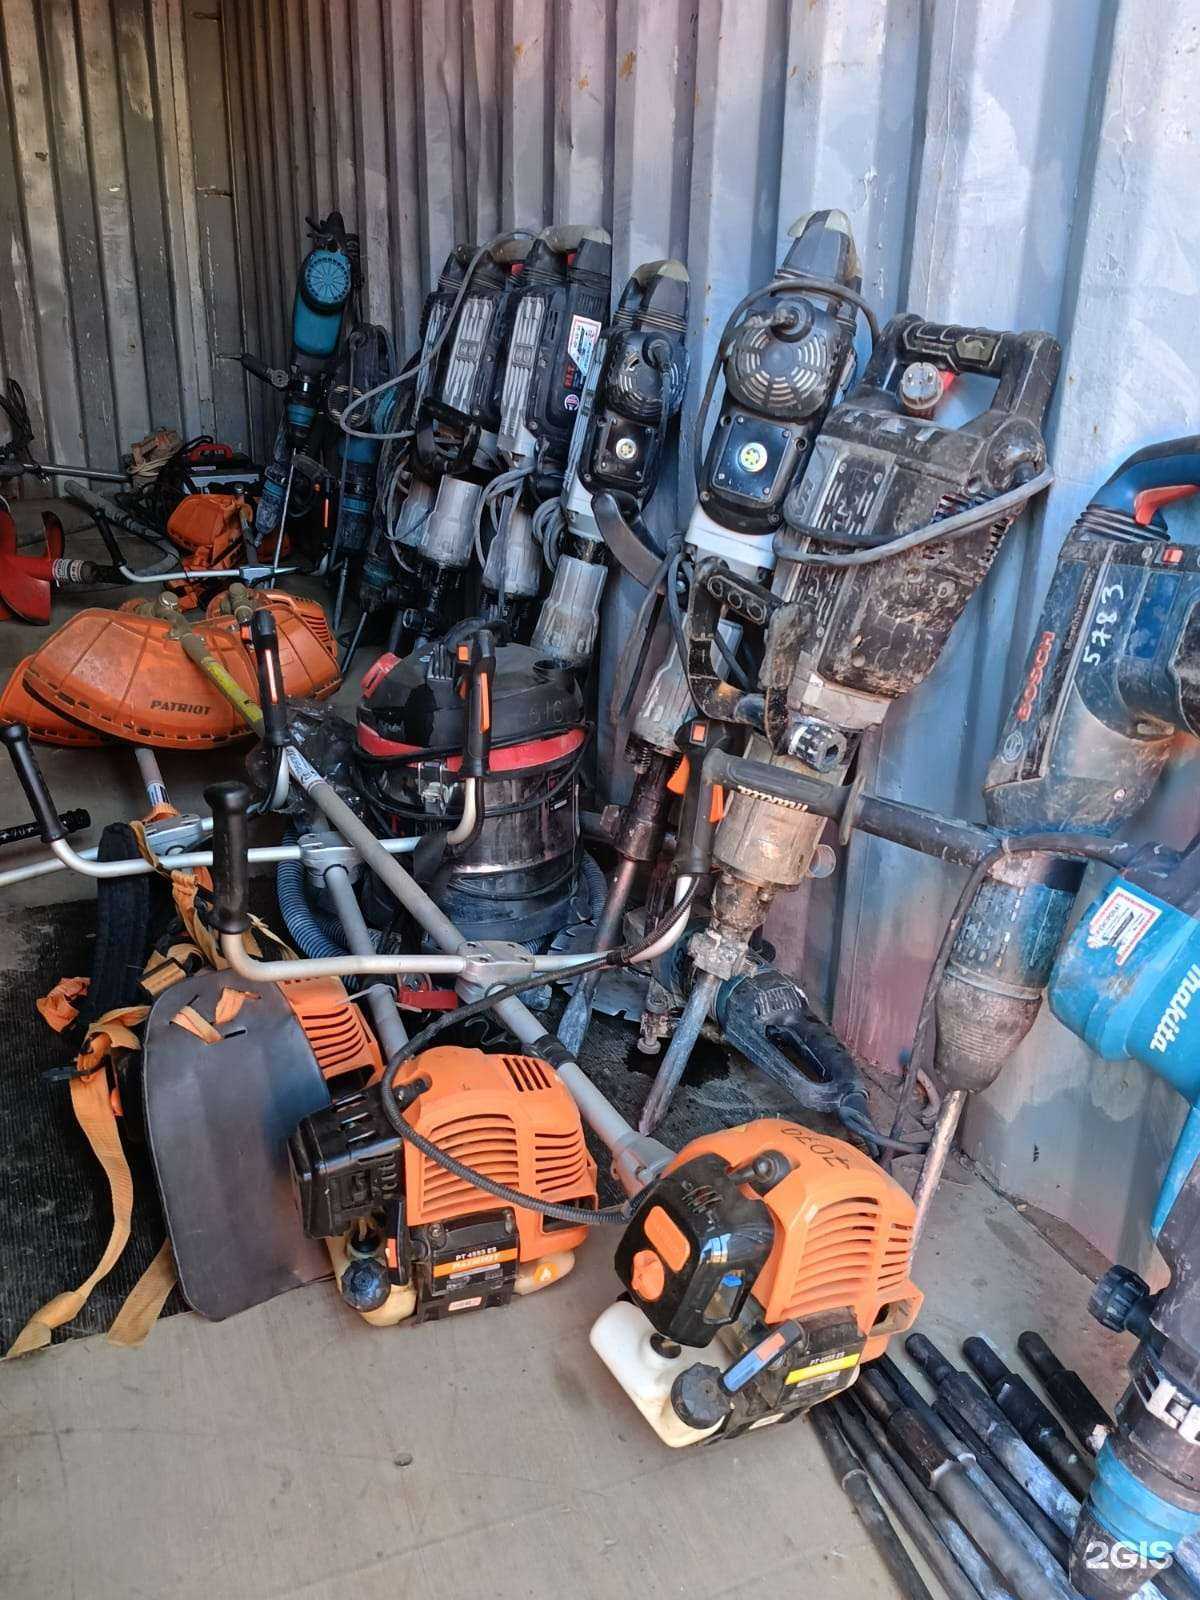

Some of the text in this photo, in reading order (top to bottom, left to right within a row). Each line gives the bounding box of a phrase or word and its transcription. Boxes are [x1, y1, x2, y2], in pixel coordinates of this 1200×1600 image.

[1083, 584, 1124, 666] 5783
[150, 700, 210, 716] PATRIOT
[1017, 631, 1055, 722] BOSCH
